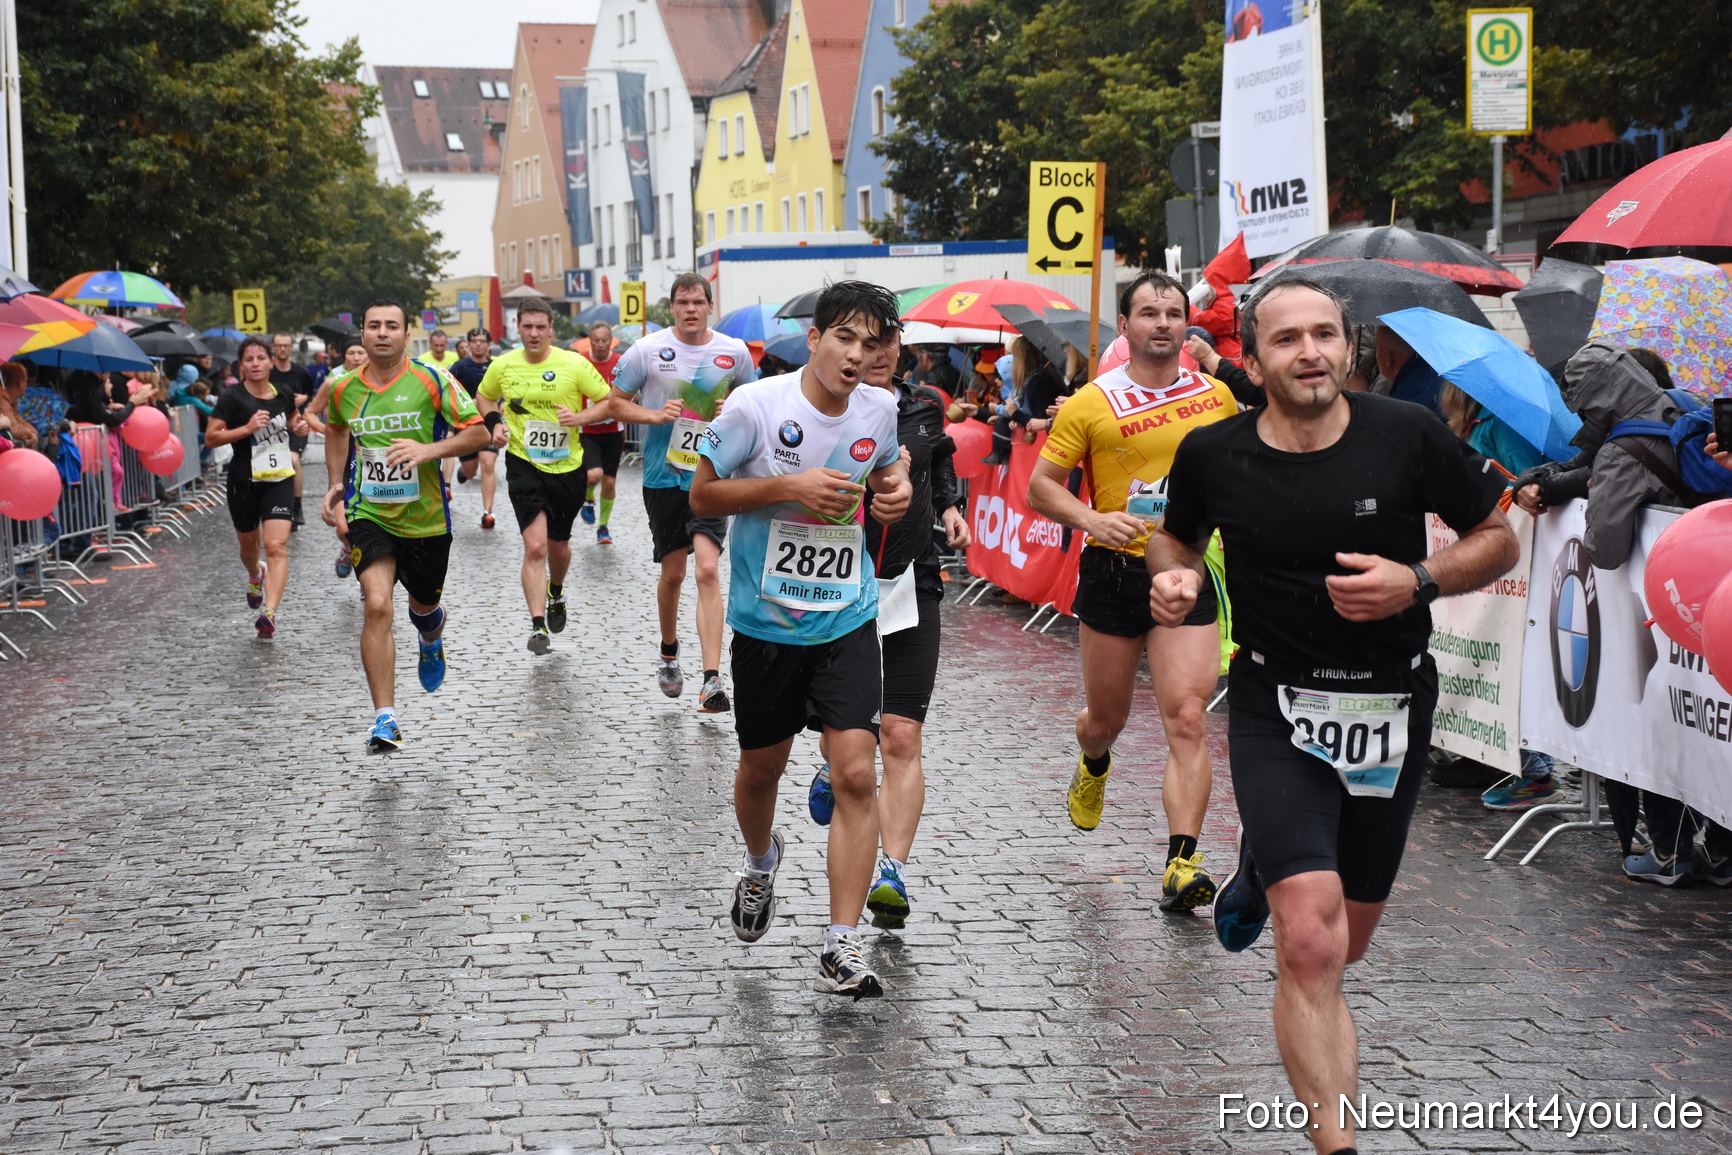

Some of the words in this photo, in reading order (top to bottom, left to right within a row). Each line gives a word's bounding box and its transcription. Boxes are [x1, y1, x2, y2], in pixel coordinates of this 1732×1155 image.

[1489, 29, 1510, 55] H
[1480, 70, 1518, 78] Marktplatz
[1039, 167, 1096, 187] Block
[1047, 196, 1084, 251] C
[237, 291, 260, 300] Block
[622, 282, 642, 292] Block
[242, 303, 258, 324] D
[627, 295, 639, 315] D
[348, 412, 422, 436] BOCK
[1119, 412, 1174, 439] MAX
[1175, 395, 1224, 421] BÖGL
[529, 431, 568, 448] 2917
[269, 454, 278, 468] 5
[773, 455, 801, 467] Neumarkt
[774, 448, 801, 462] PARTL
[778, 529, 809, 539] NeuerMarkt
[814, 527, 857, 540] BOCK
[775, 541, 854, 579] 2820
[1552, 542, 1596, 606] BMW
[779, 582, 810, 598] Amir
[812, 587, 842, 600] Reza
[1312, 668, 1373, 680] 21RUN.COM
[1291, 701, 1331, 712] euerMarkt
[1338, 697, 1400, 712] BOCK
